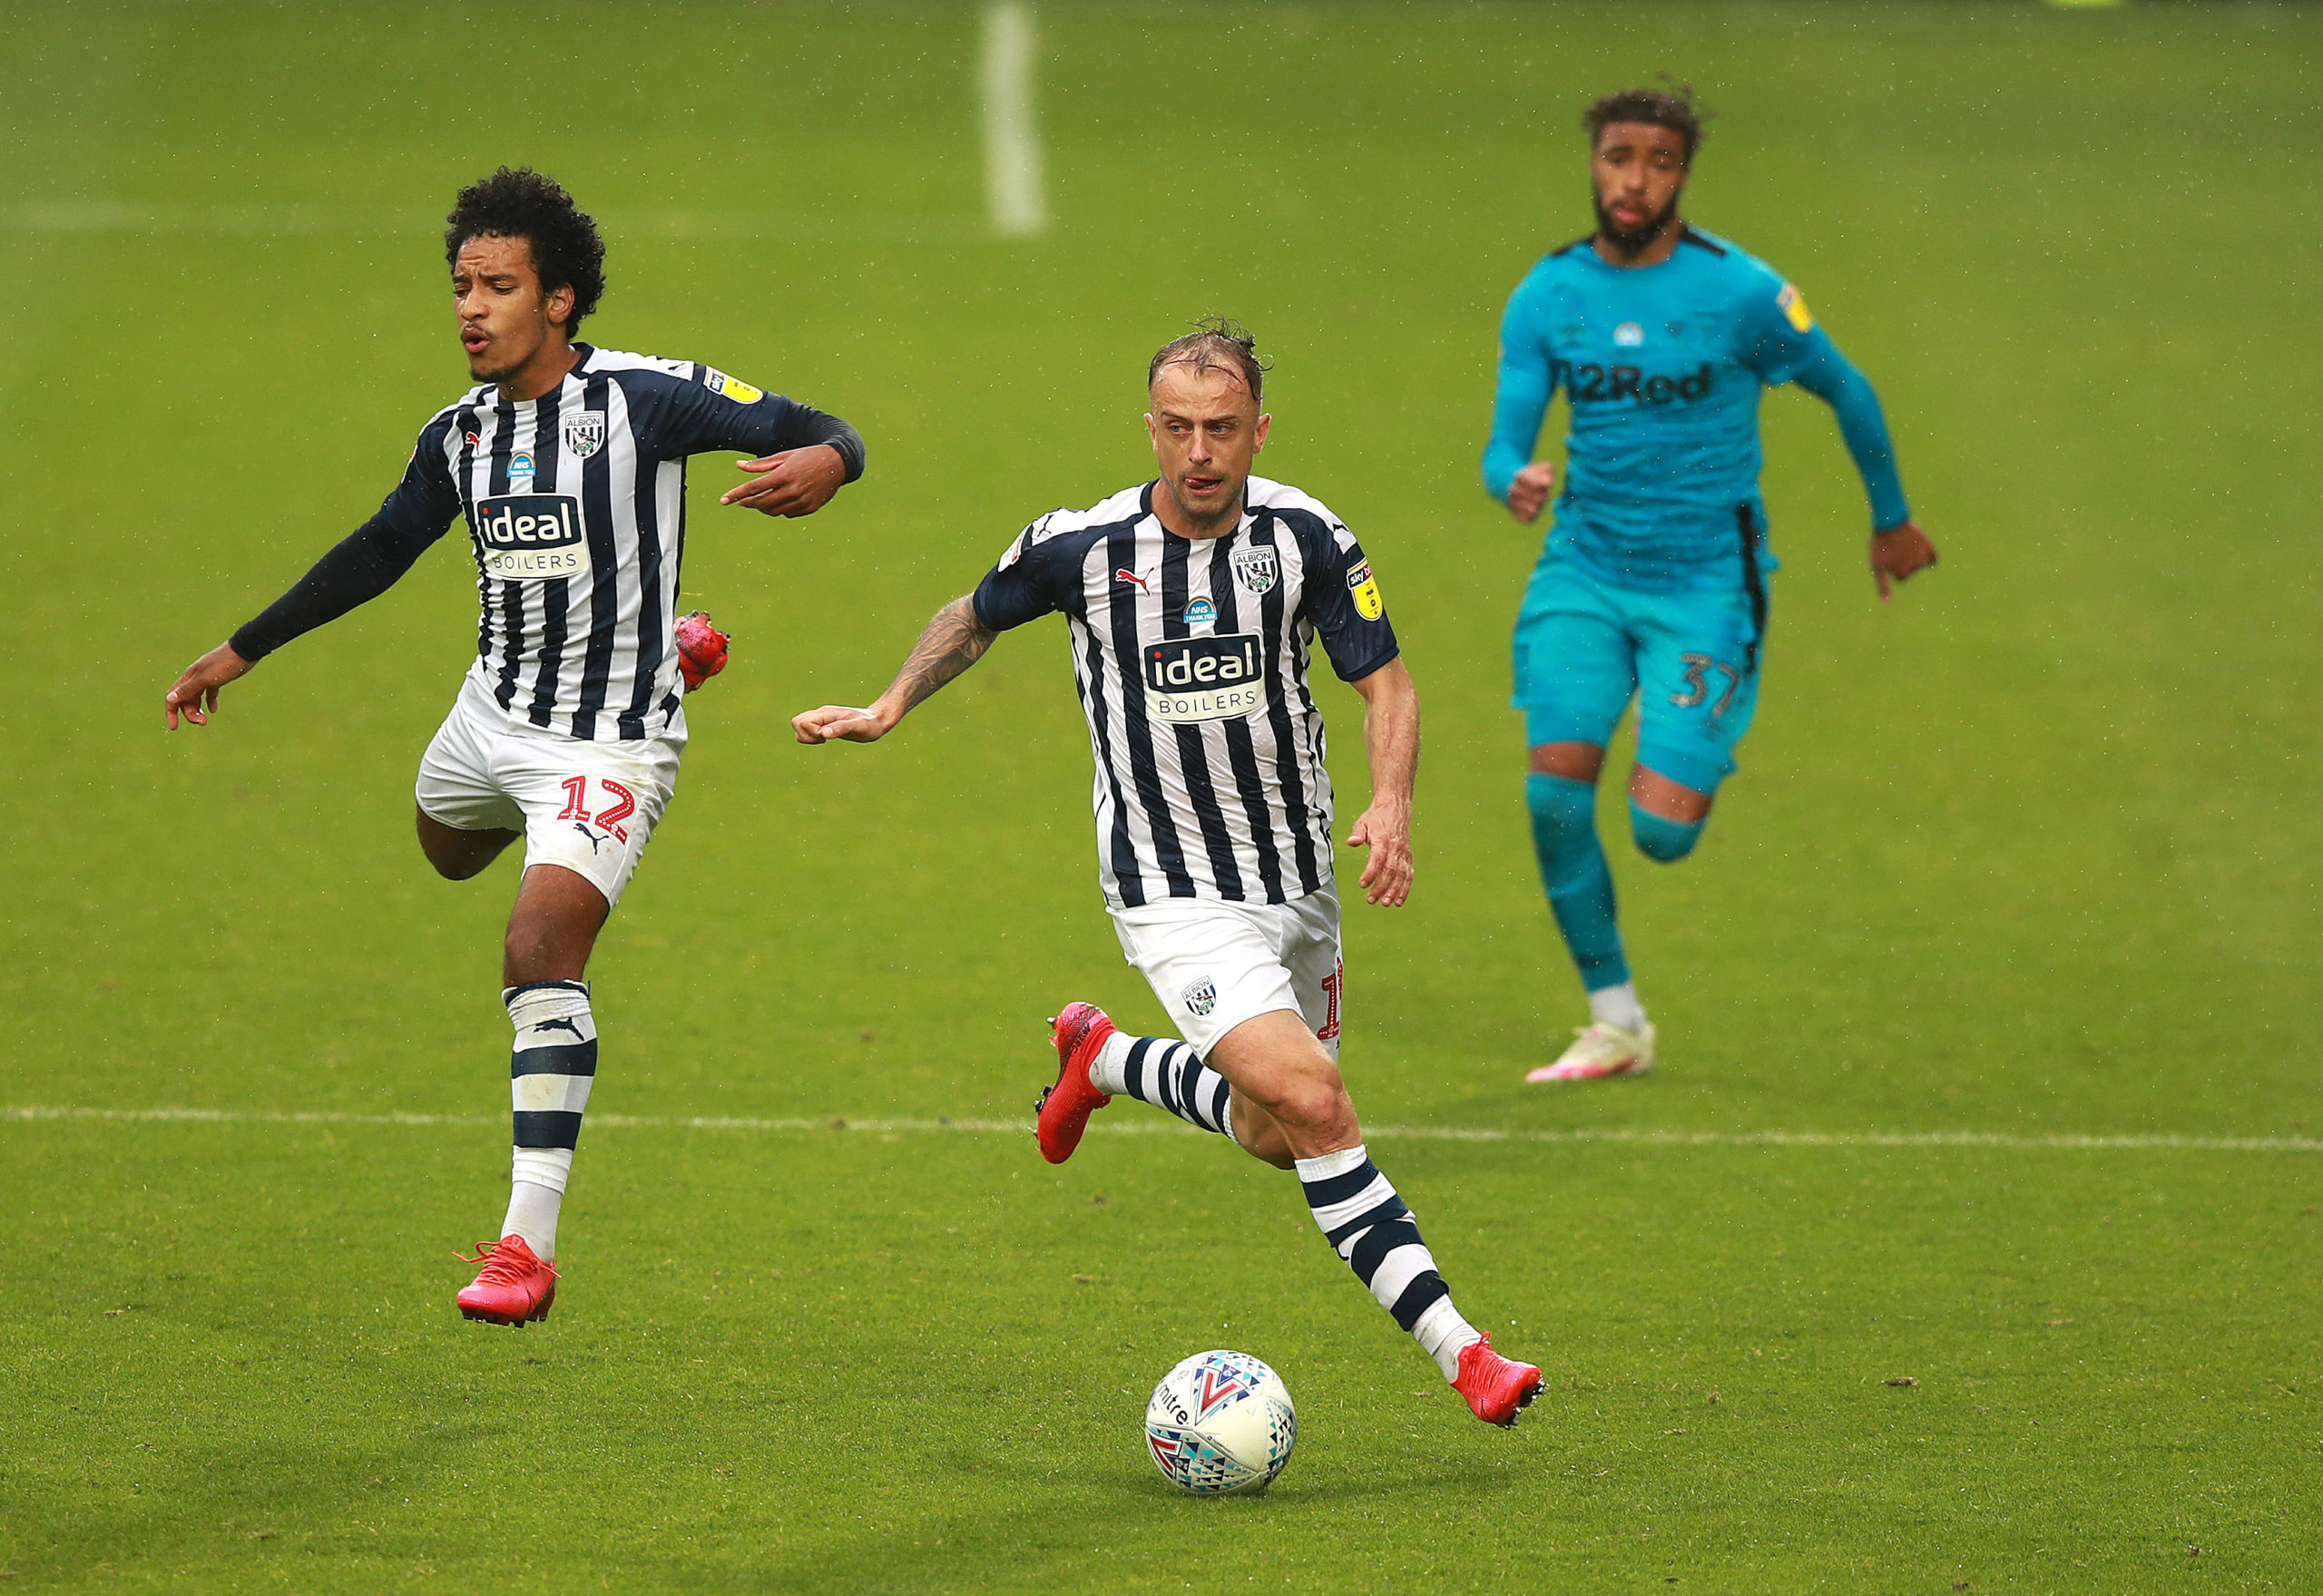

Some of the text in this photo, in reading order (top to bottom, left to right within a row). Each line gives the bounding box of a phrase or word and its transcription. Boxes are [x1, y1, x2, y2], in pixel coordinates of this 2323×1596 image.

[567, 418, 600, 426] ALBION
[482, 502, 573, 543] ideal
[492, 553, 576, 570] BOILERS
[1237, 553, 1270, 563] ALBION
[1349, 571, 1364, 585] sky
[1191, 605, 1209, 614] NHS
[1154, 641, 1254, 687] ideal
[1670, 652, 1740, 719] 37
[1159, 690, 1256, 714] BOILERS
[556, 775, 635, 846] 12
[1184, 980, 1210, 999] ALBION
[1317, 955, 1343, 1041] 1
[1157, 1384, 1189, 1425] mitre
